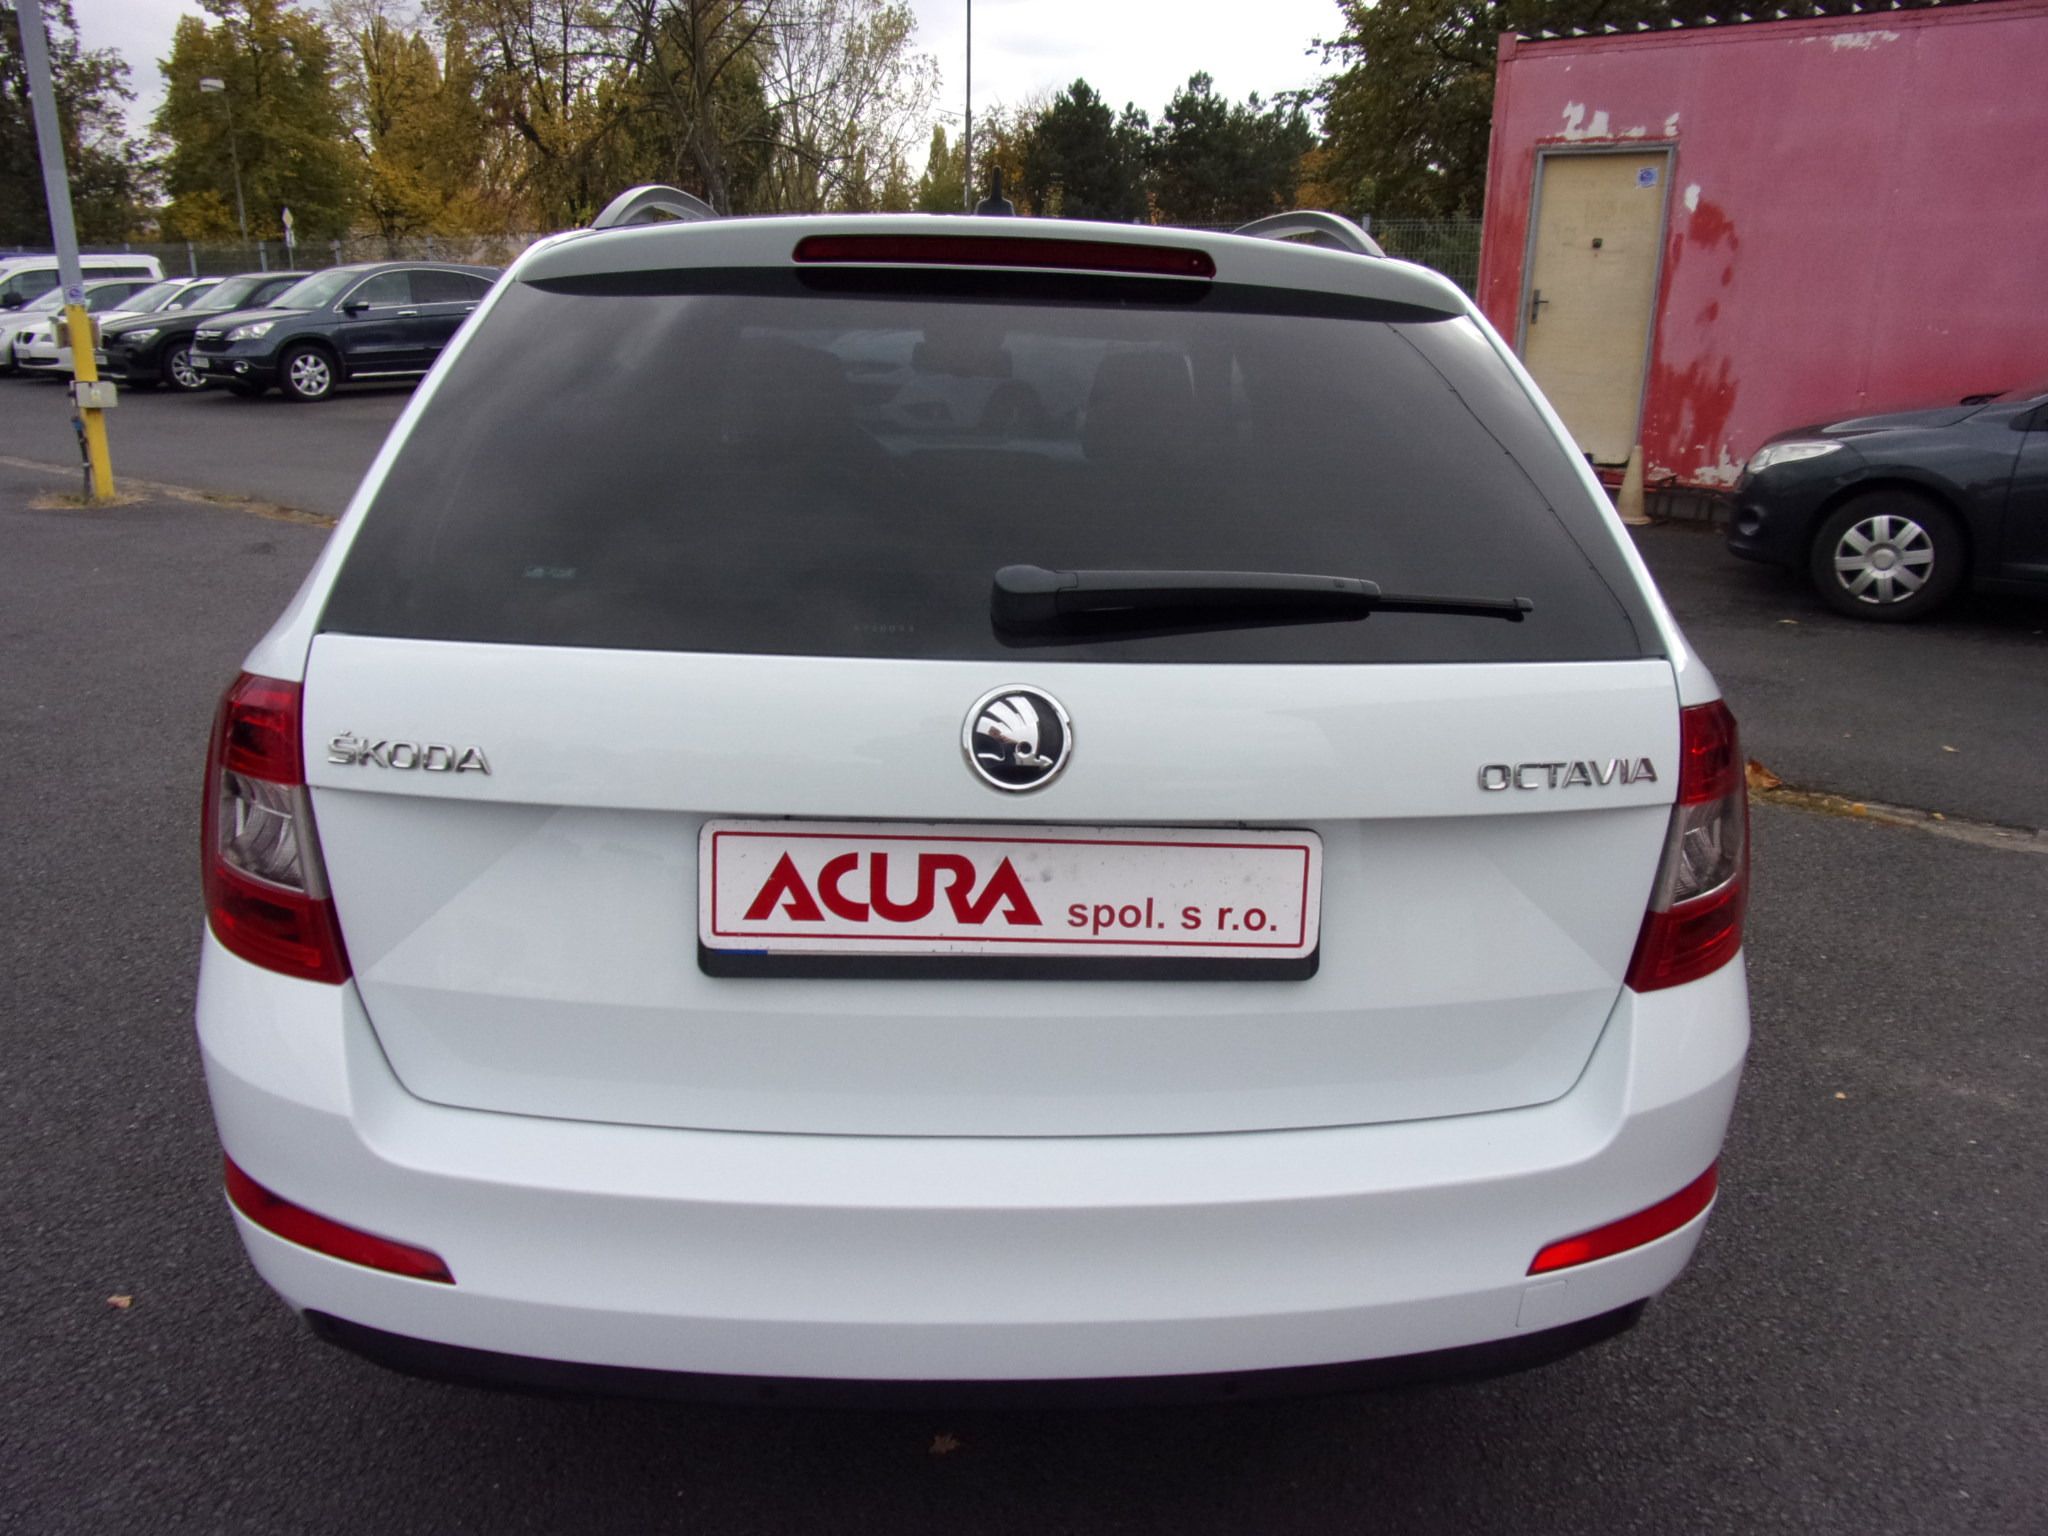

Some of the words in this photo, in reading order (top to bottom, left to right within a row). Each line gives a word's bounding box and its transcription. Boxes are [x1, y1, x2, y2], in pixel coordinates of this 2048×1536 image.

[1479, 757, 1658, 791] OCTAVIA
[742, 850, 1043, 926] ACURA
[1067, 897, 1165, 936] spol.
[1180, 905, 1202, 930] s
[1217, 907, 1278, 932] r.o.
